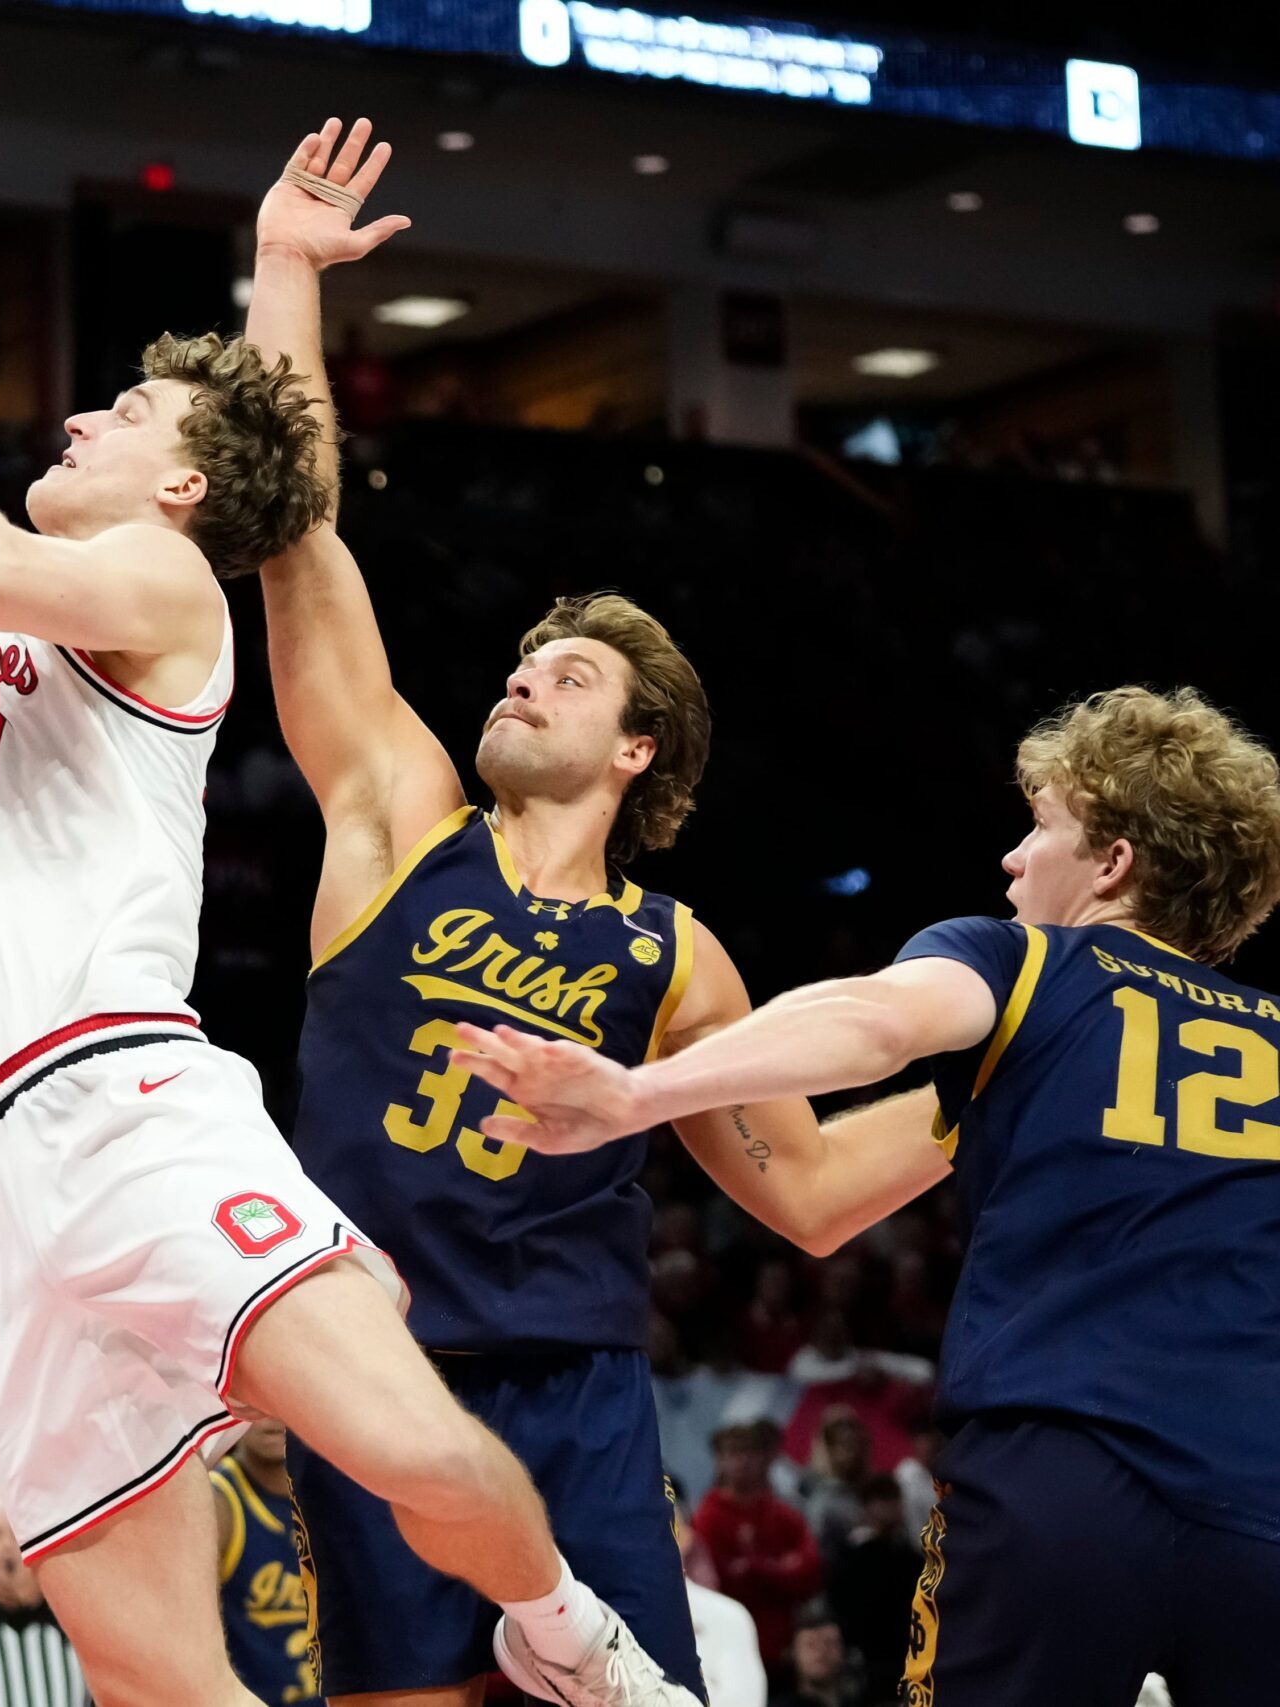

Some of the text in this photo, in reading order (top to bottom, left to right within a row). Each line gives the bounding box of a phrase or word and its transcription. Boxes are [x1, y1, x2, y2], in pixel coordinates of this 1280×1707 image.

[410, 908, 618, 1030] Irish
[1091, 945, 1280, 1022] SUNDRA
[1102, 986, 1280, 1160] 12
